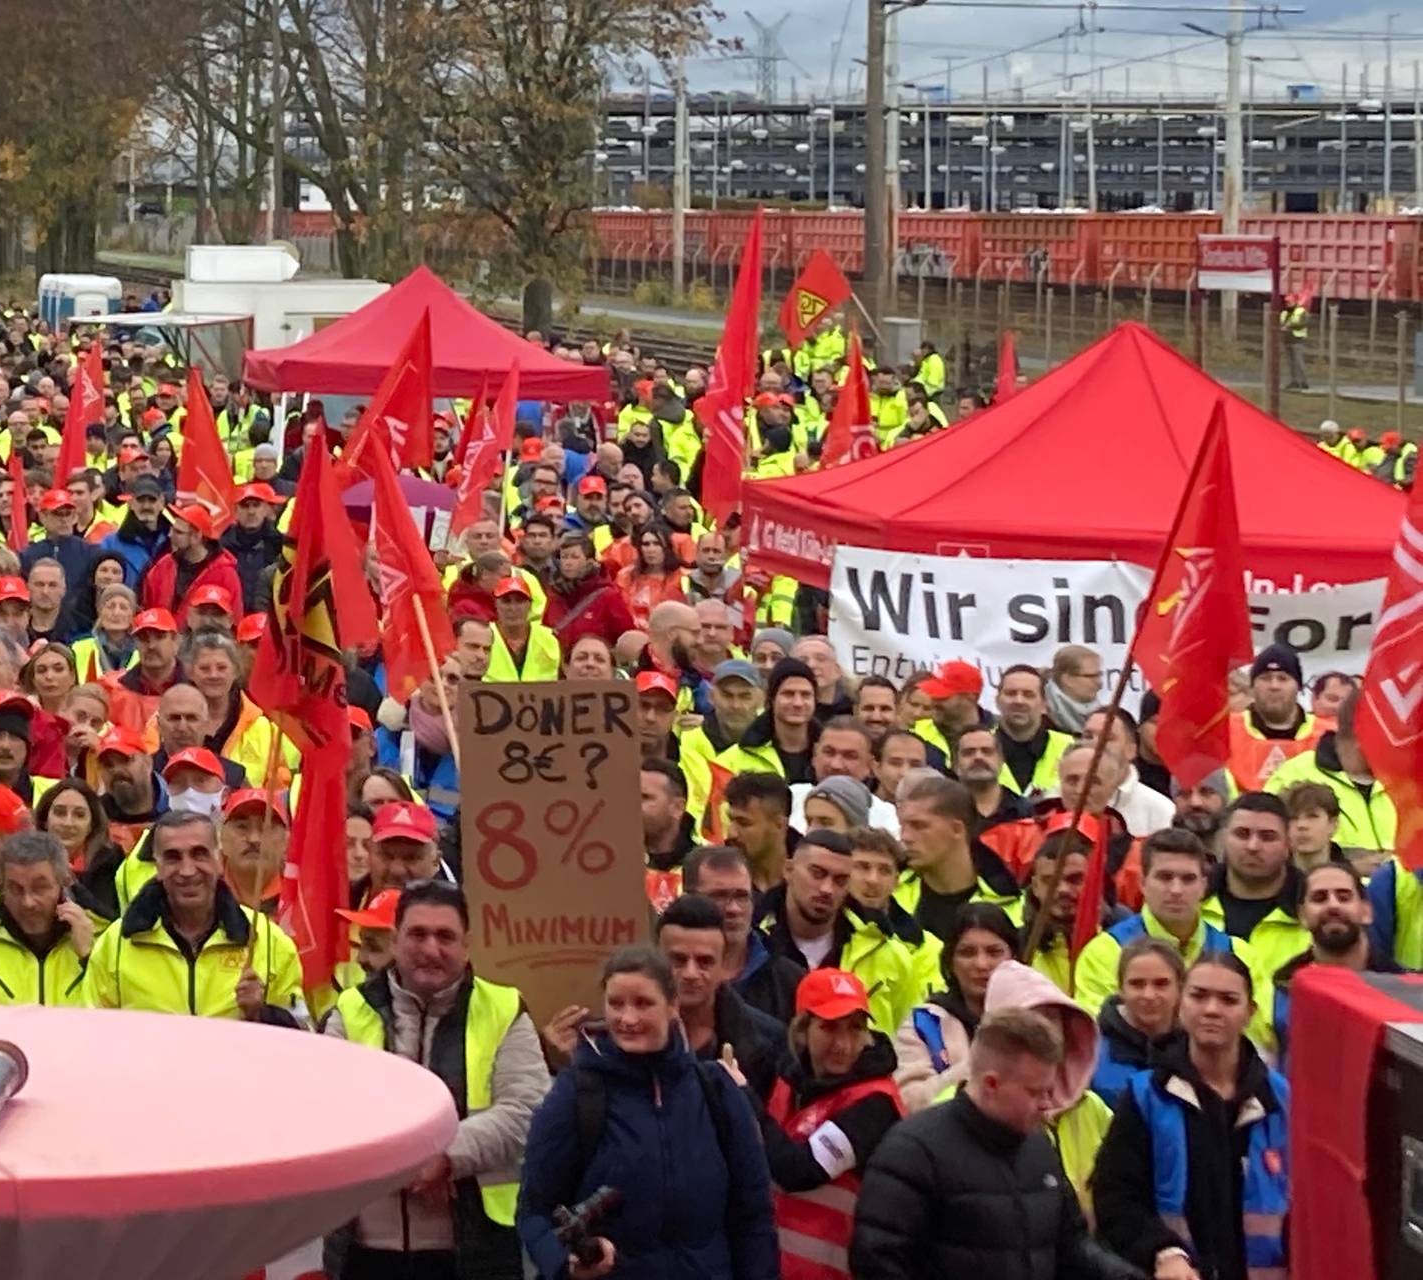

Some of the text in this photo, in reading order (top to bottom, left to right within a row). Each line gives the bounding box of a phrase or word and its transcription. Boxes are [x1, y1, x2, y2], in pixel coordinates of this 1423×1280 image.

[846, 566, 977, 641] Wir
[1007, 577, 1146, 645] sin
[475, 799, 615, 891] 8%
